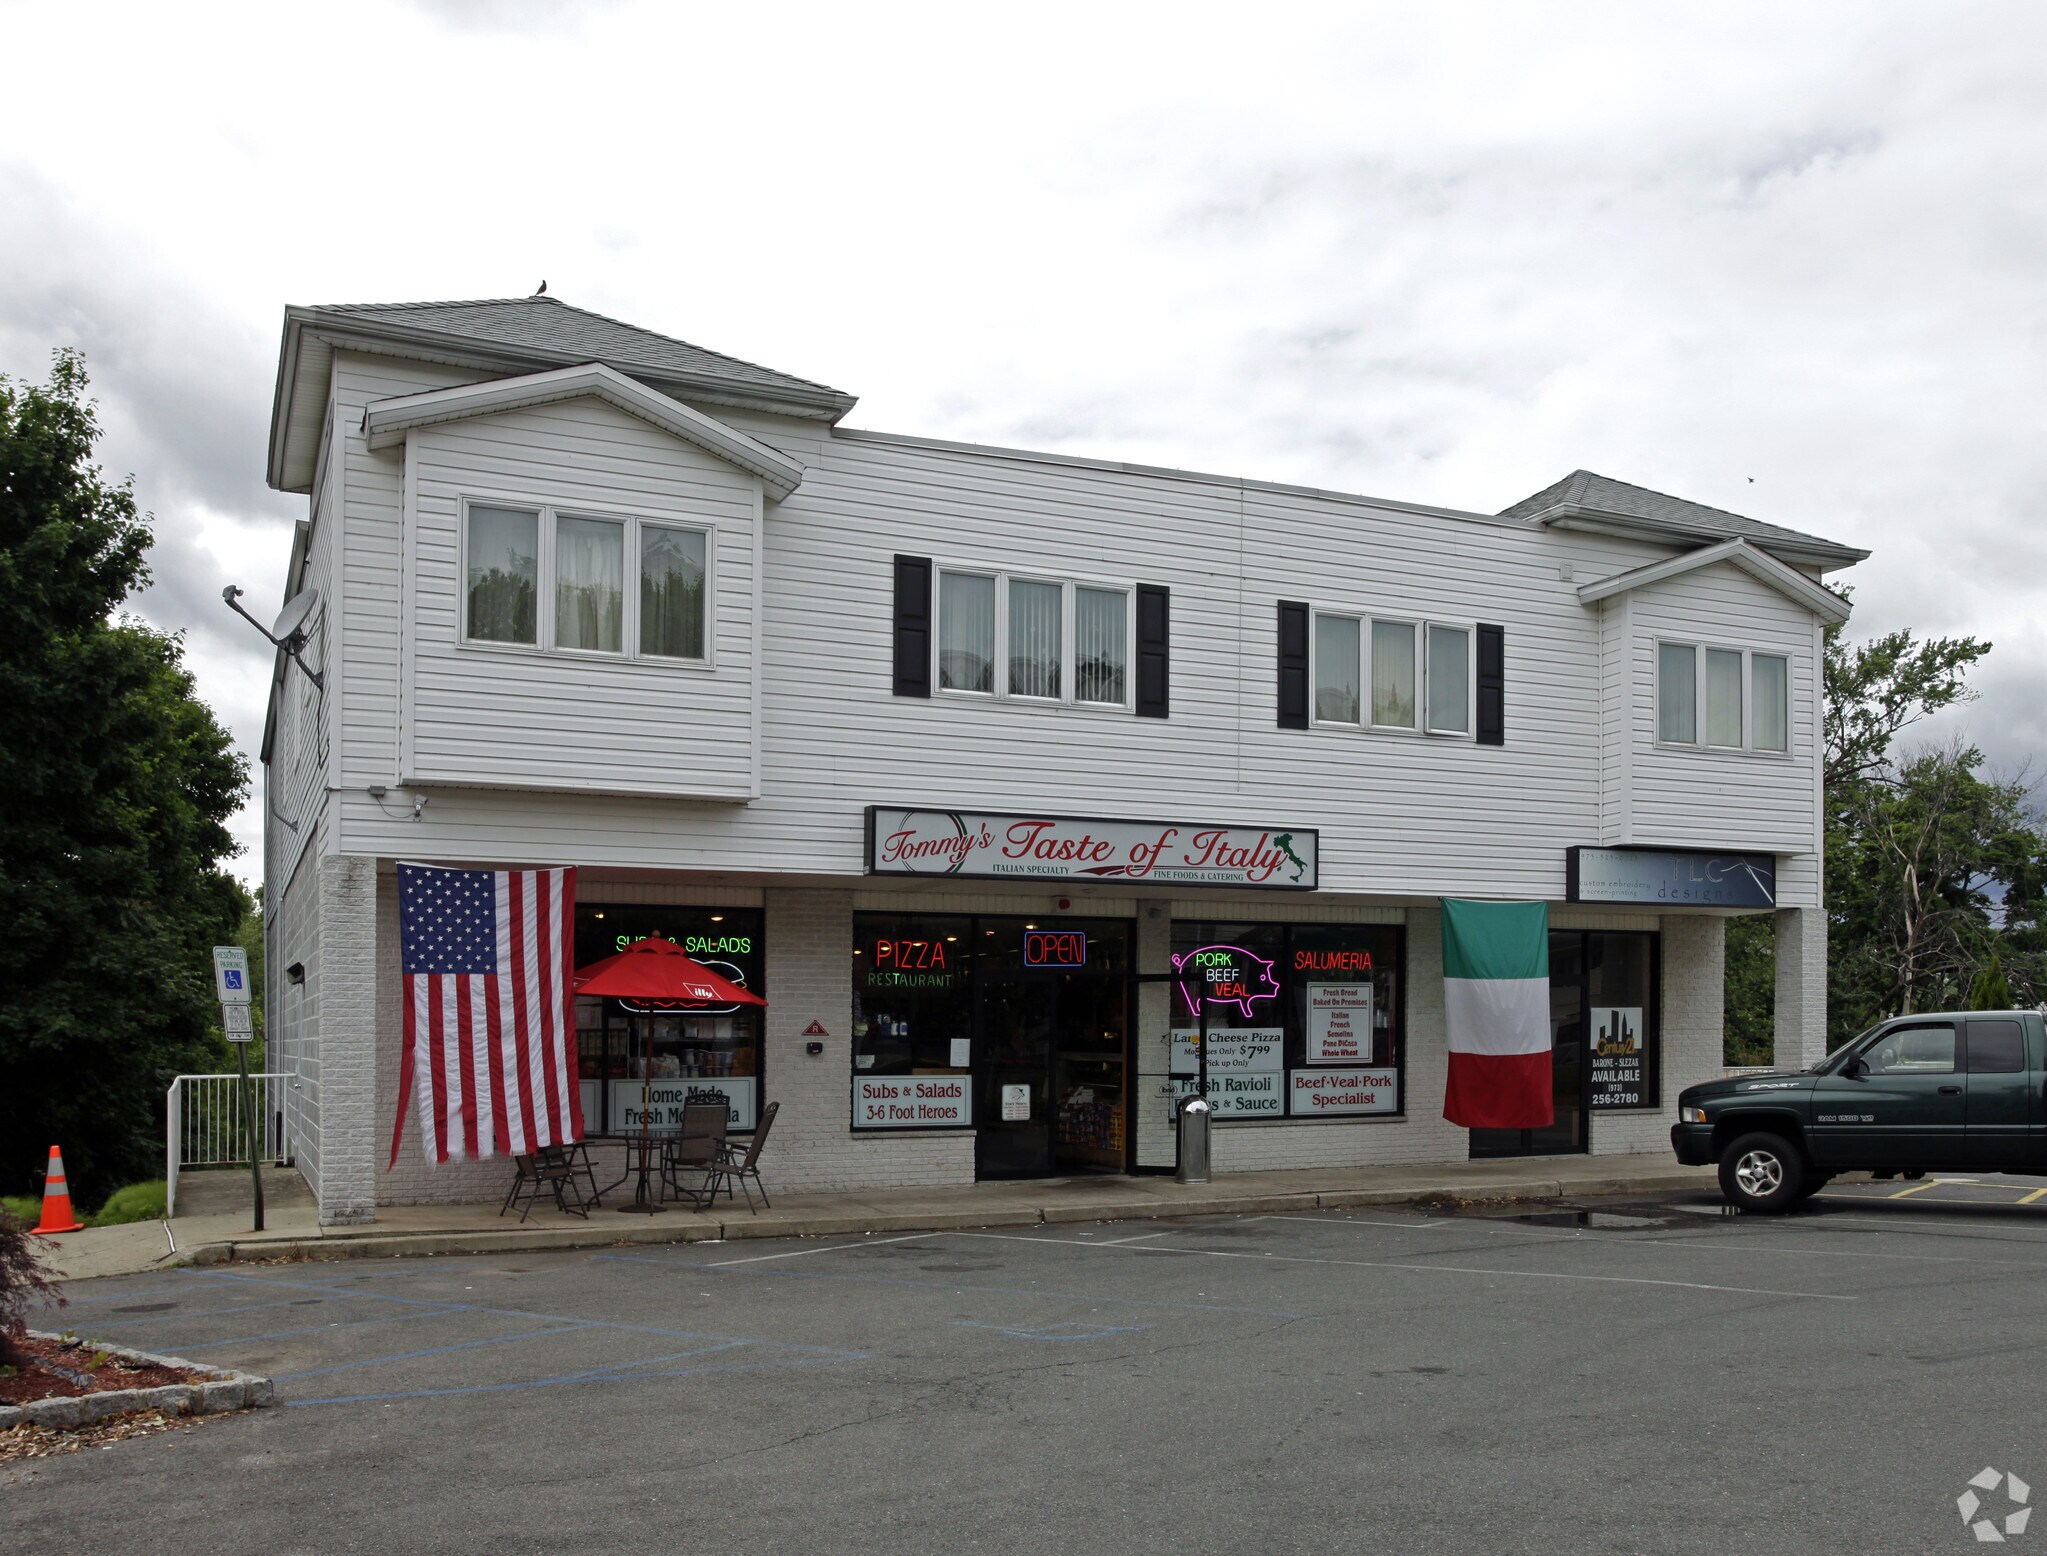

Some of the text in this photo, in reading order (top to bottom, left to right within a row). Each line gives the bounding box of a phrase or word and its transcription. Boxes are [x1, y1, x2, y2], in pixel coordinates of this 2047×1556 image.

[881, 821, 1288, 882] Tommy's Taste of Italy
[993, 864, 1069, 875] ITALIAN SPECIALTY
[1173, 871, 1199, 880] FOODS
[1207, 872, 1244, 881] CATERING
[1667, 857, 1723, 883] TLC
[1609, 879, 1650, 889] embroidery
[1657, 880, 1734, 903] designs
[685, 937, 751, 953] SALADS
[1027, 934, 1083, 964] OPEN
[216, 951, 244, 960] RESERVED
[877, 940, 945, 969] PIZZA
[1196, 953, 1232, 966] PORK
[1294, 951, 1372, 970] SALUMERIA
[220, 961, 243, 969] PARKING
[868, 972, 952, 986] RESTAURANT
[1206, 968, 1240, 981] BEEF
[694, 988, 713, 998] illy
[1215, 983, 1250, 997] VEAL
[1313, 998, 1331, 1006] Baked
[1341, 998, 1367, 1006] Premises
[812, 1025, 819, 1033] R
[1327, 1030, 1353, 1038] Semolina
[1208, 1032, 1248, 1043] Cheese
[1251, 1032, 1280, 1042] Pizza
[1220, 1047, 1236, 1056] Only
[1233, 1060, 1249, 1068] Only
[1592, 1058, 1614, 1068] BARONE
[1619, 1057, 1639, 1067] SLEZAK
[1591, 1069, 1640, 1082] AVAILABLE
[863, 1083, 962, 1099] Subs & Salads
[1225, 1077, 1271, 1092] Ravioli
[1608, 1083, 1623, 1092] (973)
[1748, 1082, 1799, 1090] SPORT
[1223, 1100, 1231, 1108] &
[1236, 1097, 1278, 1110] Sauce
[1312, 1092, 1375, 1108] Specialist
[867, 1104, 958, 1120] 3-6 Foot Heroes
